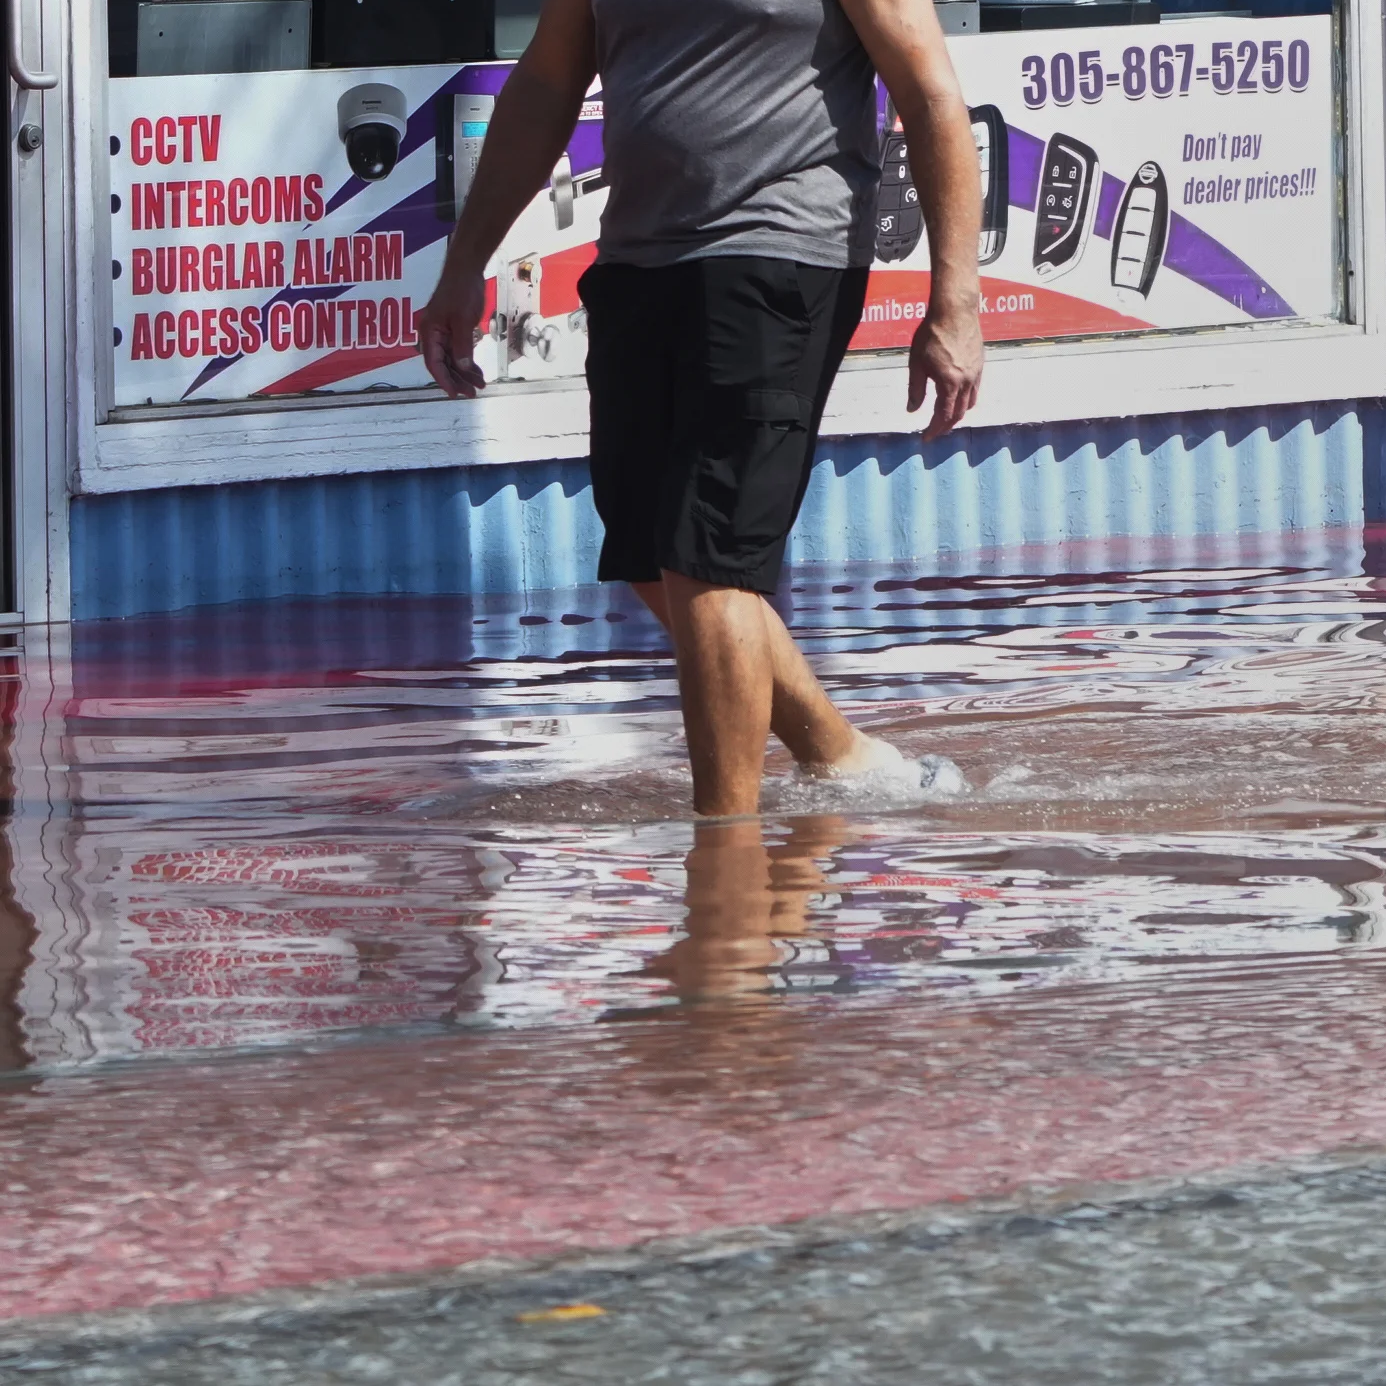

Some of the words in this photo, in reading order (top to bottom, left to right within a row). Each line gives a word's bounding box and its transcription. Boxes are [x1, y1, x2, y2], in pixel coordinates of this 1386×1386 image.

[1021, 39, 1311, 111] 305-867-5250
[130, 114, 222, 166] CCTV
[1183, 132, 1227, 162] Don't
[1230, 133, 1262, 162] pay
[131, 173, 325, 231] INTERCOMS
[1183, 175, 1241, 205] dealer
[1245, 167, 1317, 203] prices!!!
[131, 240, 286, 296] BURGLAR
[291, 232, 404, 287] ALARM
[130, 305, 263, 361] ACCESS
[268, 296, 418, 354] CONTROL
